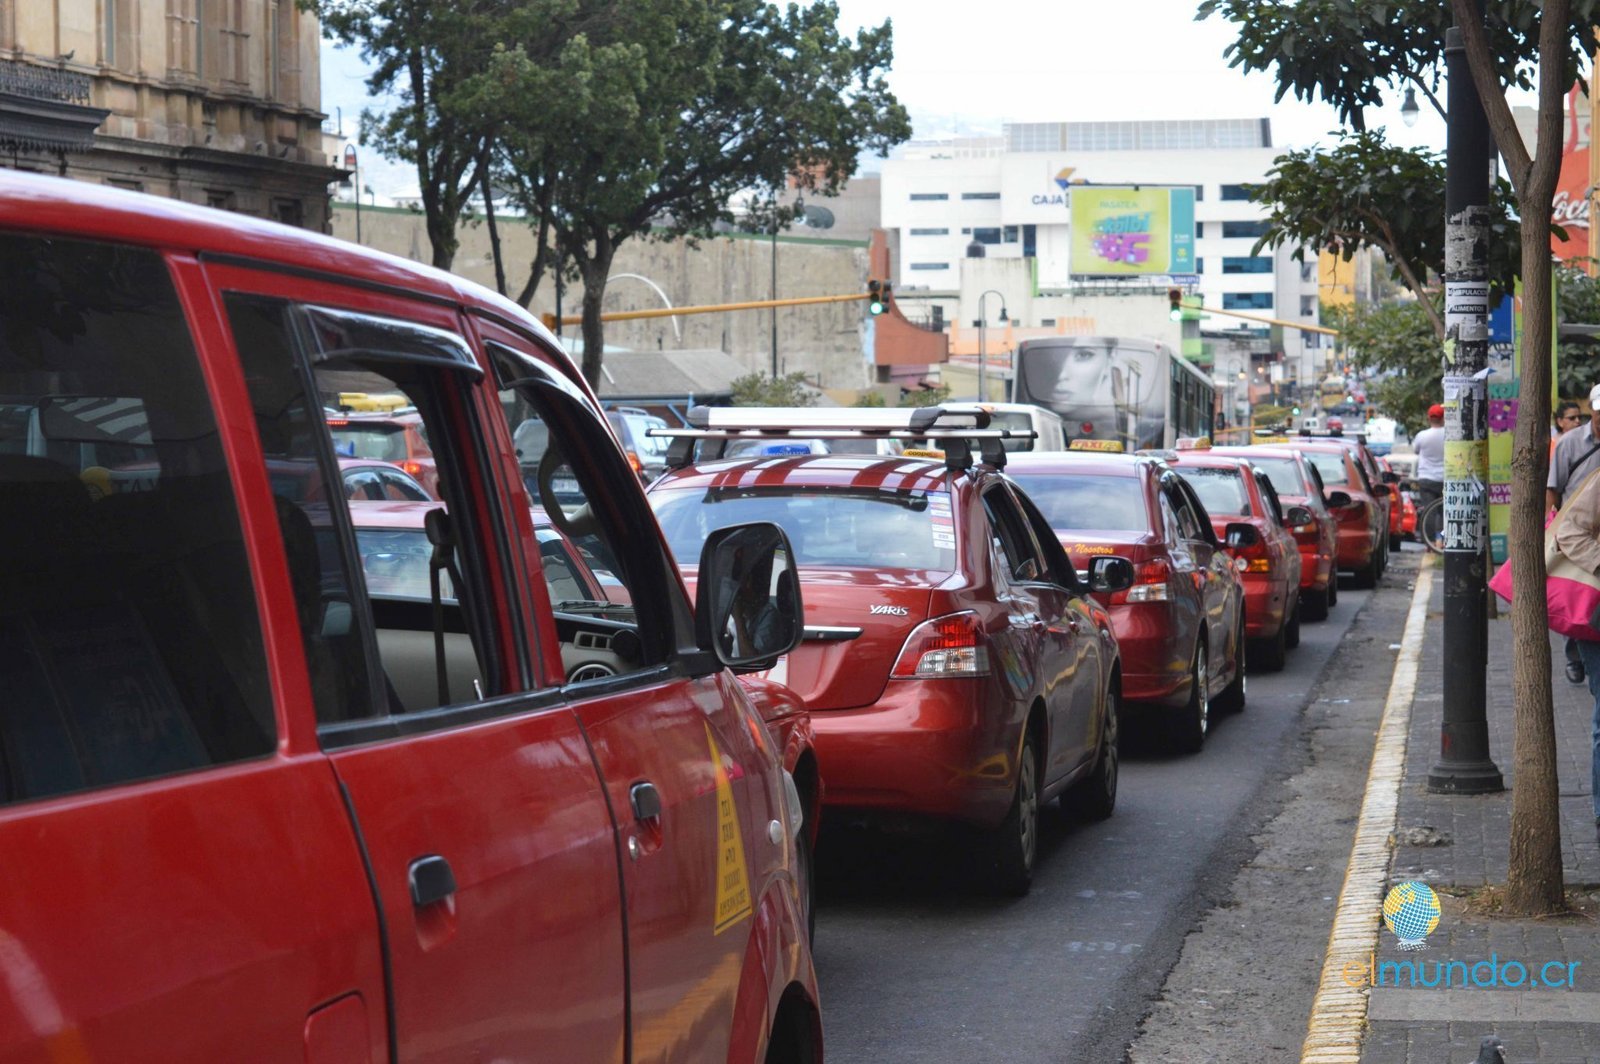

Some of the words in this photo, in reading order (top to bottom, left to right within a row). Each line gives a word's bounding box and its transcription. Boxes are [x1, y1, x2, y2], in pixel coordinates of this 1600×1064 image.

[1032, 195, 1063, 205] CAJA
[1072, 440, 1103, 449] TAXI
[1491, 485, 1501, 493] 10
[1075, 543, 1113, 554] Nosotros
